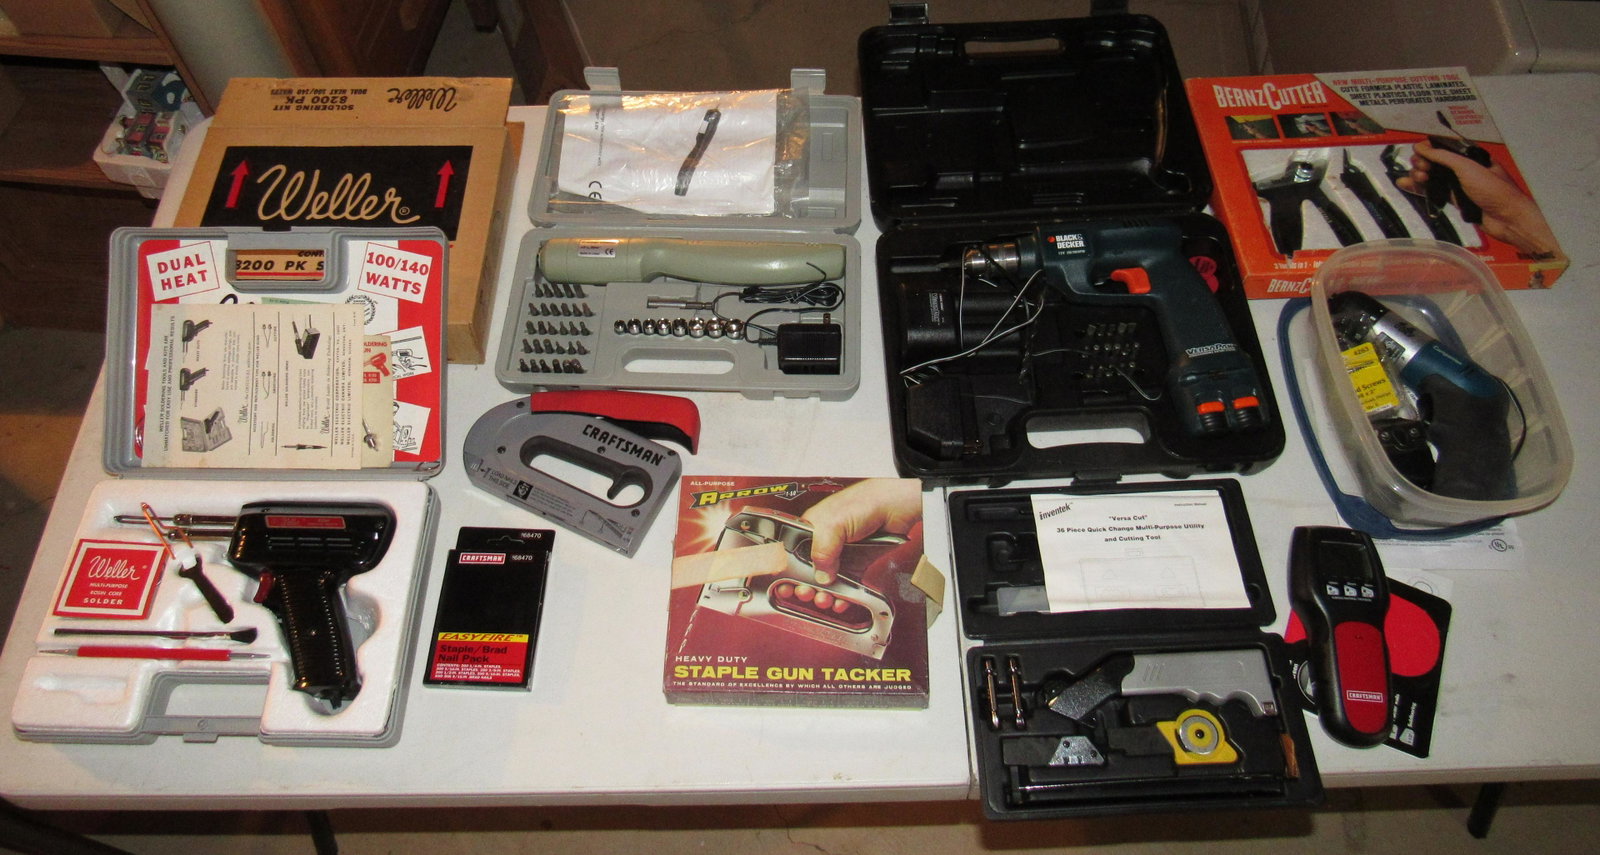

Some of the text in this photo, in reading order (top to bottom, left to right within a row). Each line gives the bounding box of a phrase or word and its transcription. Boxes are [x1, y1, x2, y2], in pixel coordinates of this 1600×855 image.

[388, 87, 458, 112] Weller
[1212, 81, 1327, 110] BERNZCUTTER
[1389, 97, 1433, 105] PERFORATED
[256, 164, 420, 224] Weller
[1057, 241, 1084, 249] DECKER
[157, 254, 206, 274] DUAL
[284, 260, 306, 270] PK
[366, 251, 429, 276] 100/140
[160, 270, 208, 291] HEAT
[366, 271, 422, 295] WATTS
[1362, 379, 1386, 390] Screws
[582, 424, 664, 466] CRAFTSMAN
[700, 484, 789, 506] ARROW
[1040, 502, 1071, 520] inventek
[88, 556, 140, 580] Weller
[438, 653, 489, 662] Nail Pack
[674, 665, 911, 681] STAPLE GUN TACKER
